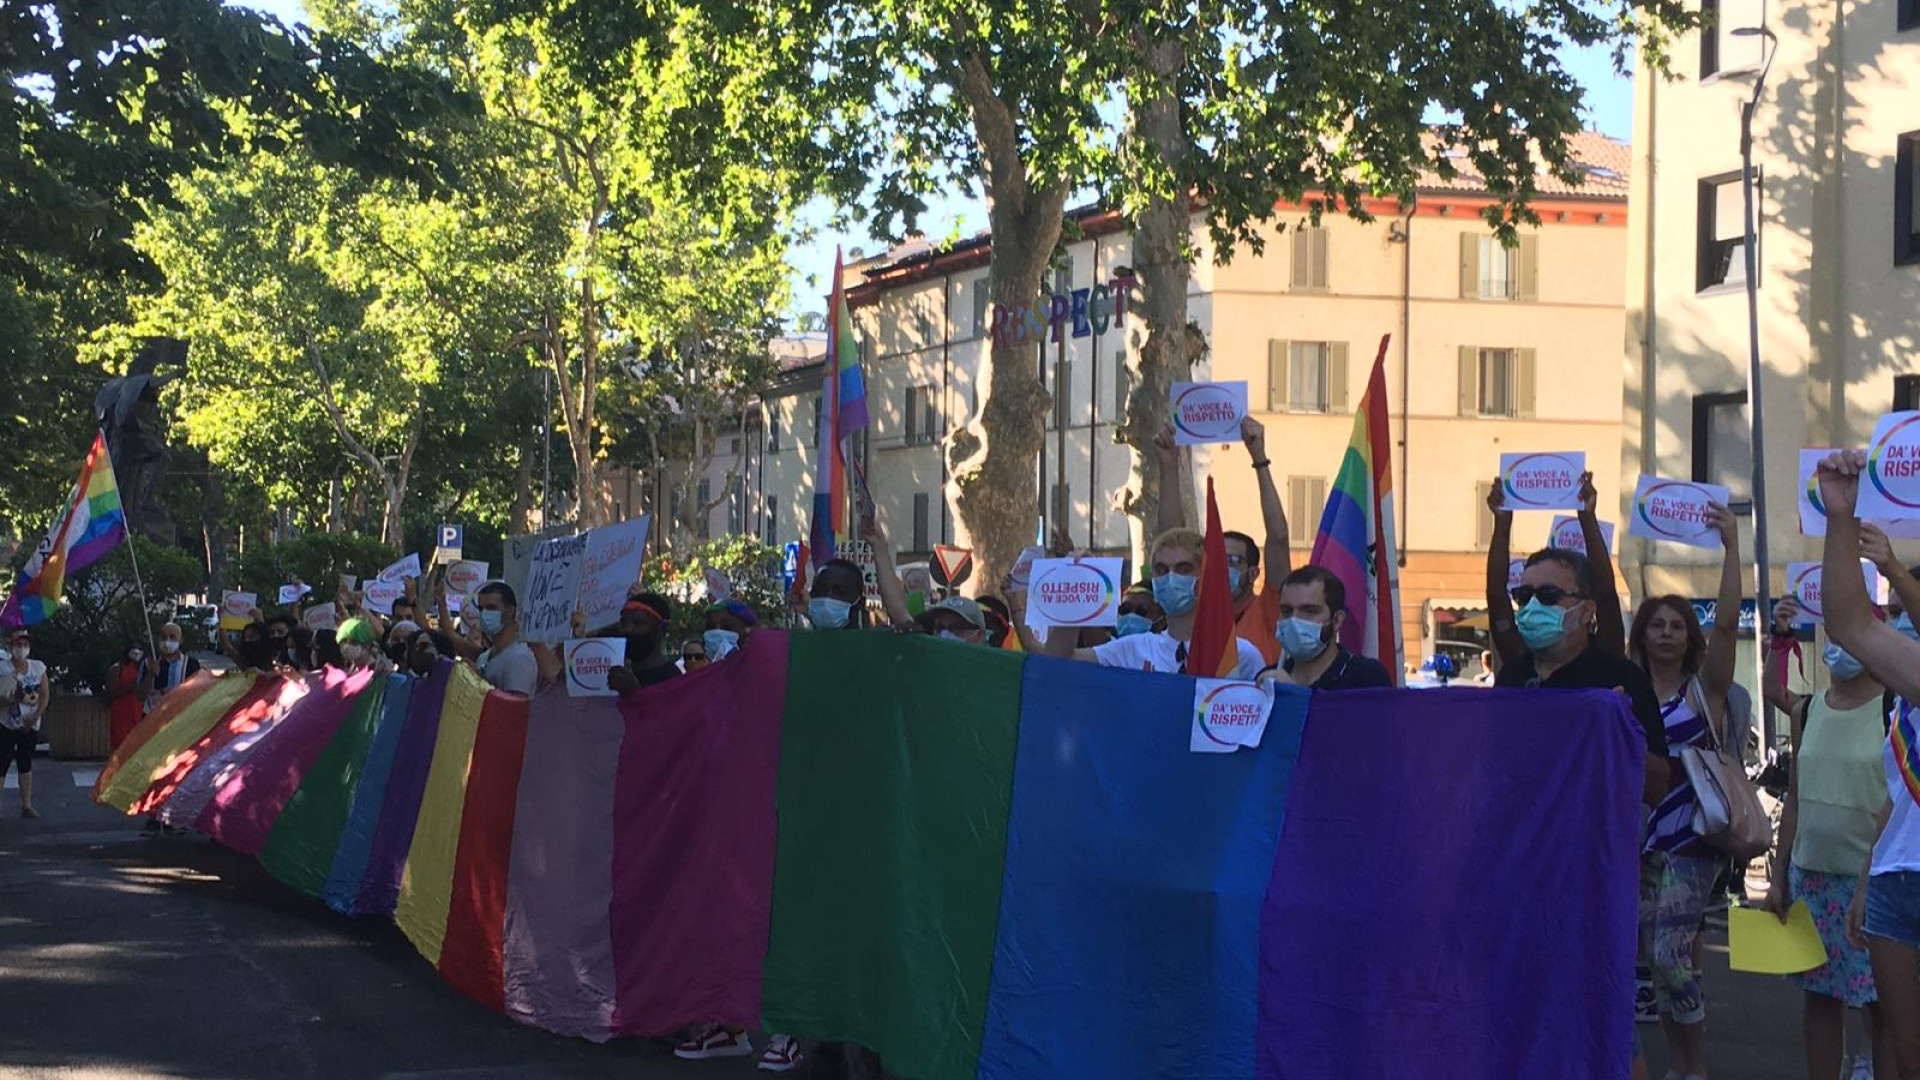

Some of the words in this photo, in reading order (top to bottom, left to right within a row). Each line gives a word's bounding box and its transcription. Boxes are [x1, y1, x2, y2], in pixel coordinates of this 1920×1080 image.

[992, 275, 1135, 347] RESPECT
[1199, 402, 1220, 411] VOCE
[1184, 411, 1235, 423] RISPETTO
[1887, 445, 1908, 458] DA'
[1533, 470, 1556, 478] VOCE
[1884, 461, 1920, 477] RISP
[1516, 478, 1571, 489] RISPETTO
[1671, 500, 1695, 512] VOCE
[1651, 505, 1709, 524] RISPETTO
[443, 527, 457, 547] P
[1041, 582, 1100, 595] RISPETTO
[1055, 594, 1082, 604] VOCE
[1212, 703, 1228, 713] DA'
[1229, 704, 1254, 714] VOCE
